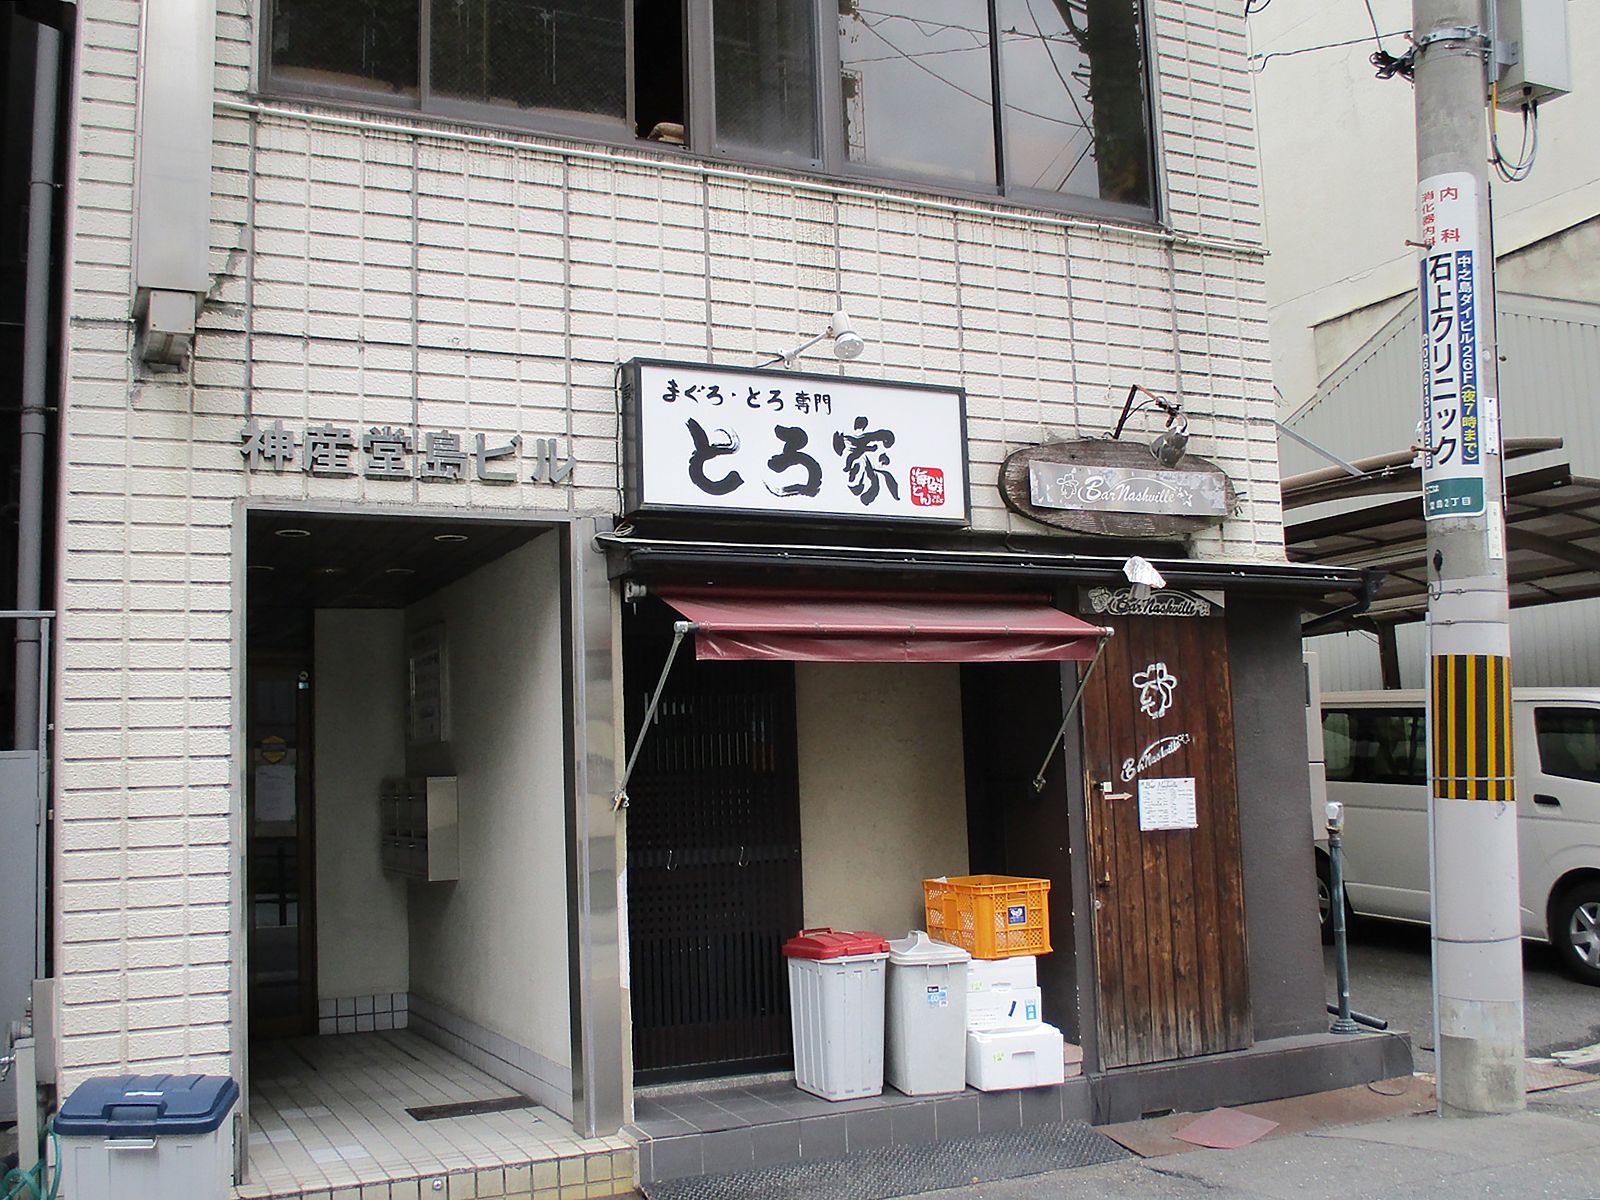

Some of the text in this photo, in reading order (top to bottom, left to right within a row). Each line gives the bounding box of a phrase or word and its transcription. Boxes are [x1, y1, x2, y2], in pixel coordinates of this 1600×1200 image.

[1440, 186, 1460, 243] 内科
[1429, 252, 1457, 466] 石上クリニック
[240, 419, 576, 484] 神産堂島ビル
[684, 415, 901, 506] とろ家
[1078, 475, 1177, 504] Bar Nashville
[1141, 598, 1197, 616] Nashville
